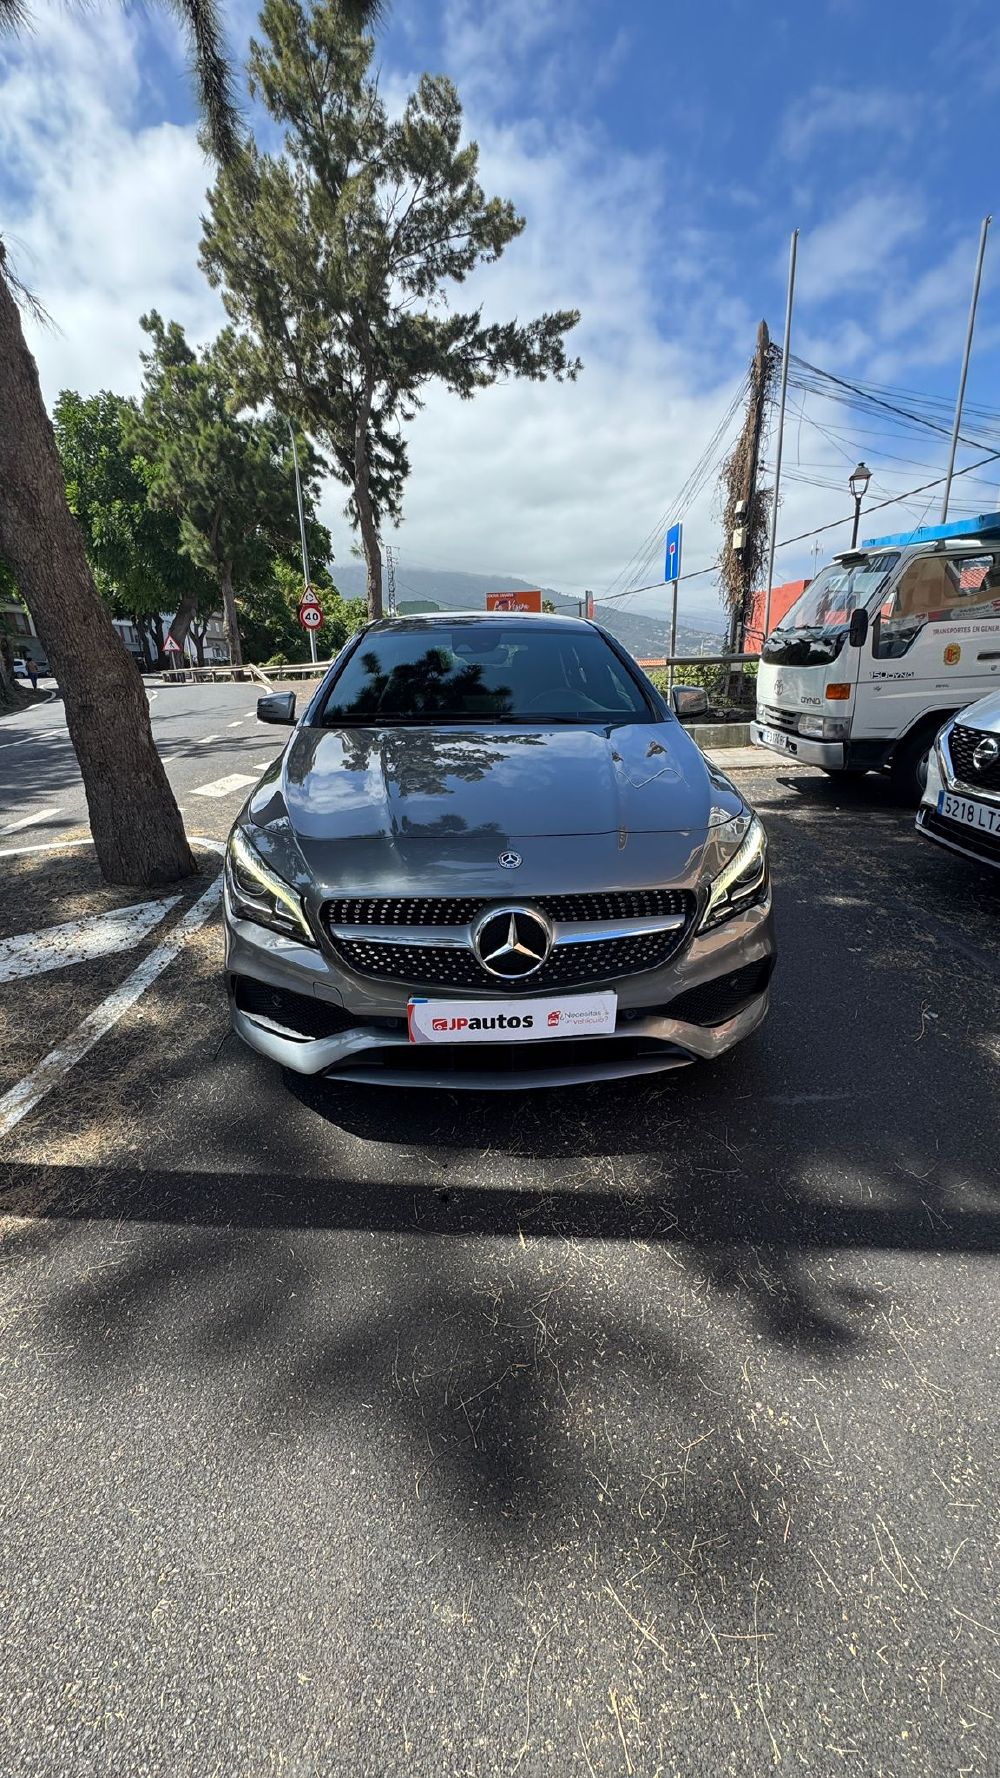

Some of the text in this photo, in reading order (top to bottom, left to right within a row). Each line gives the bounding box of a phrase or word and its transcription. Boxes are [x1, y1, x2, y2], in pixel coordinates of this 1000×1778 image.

[305, 613, 318, 621] 40
[933, 626, 971, 635] TRANSPORTES
[980, 625, 1000, 633] GENER
[945, 796, 975, 823] 5218
[449, 1014, 534, 1030] JPautos
